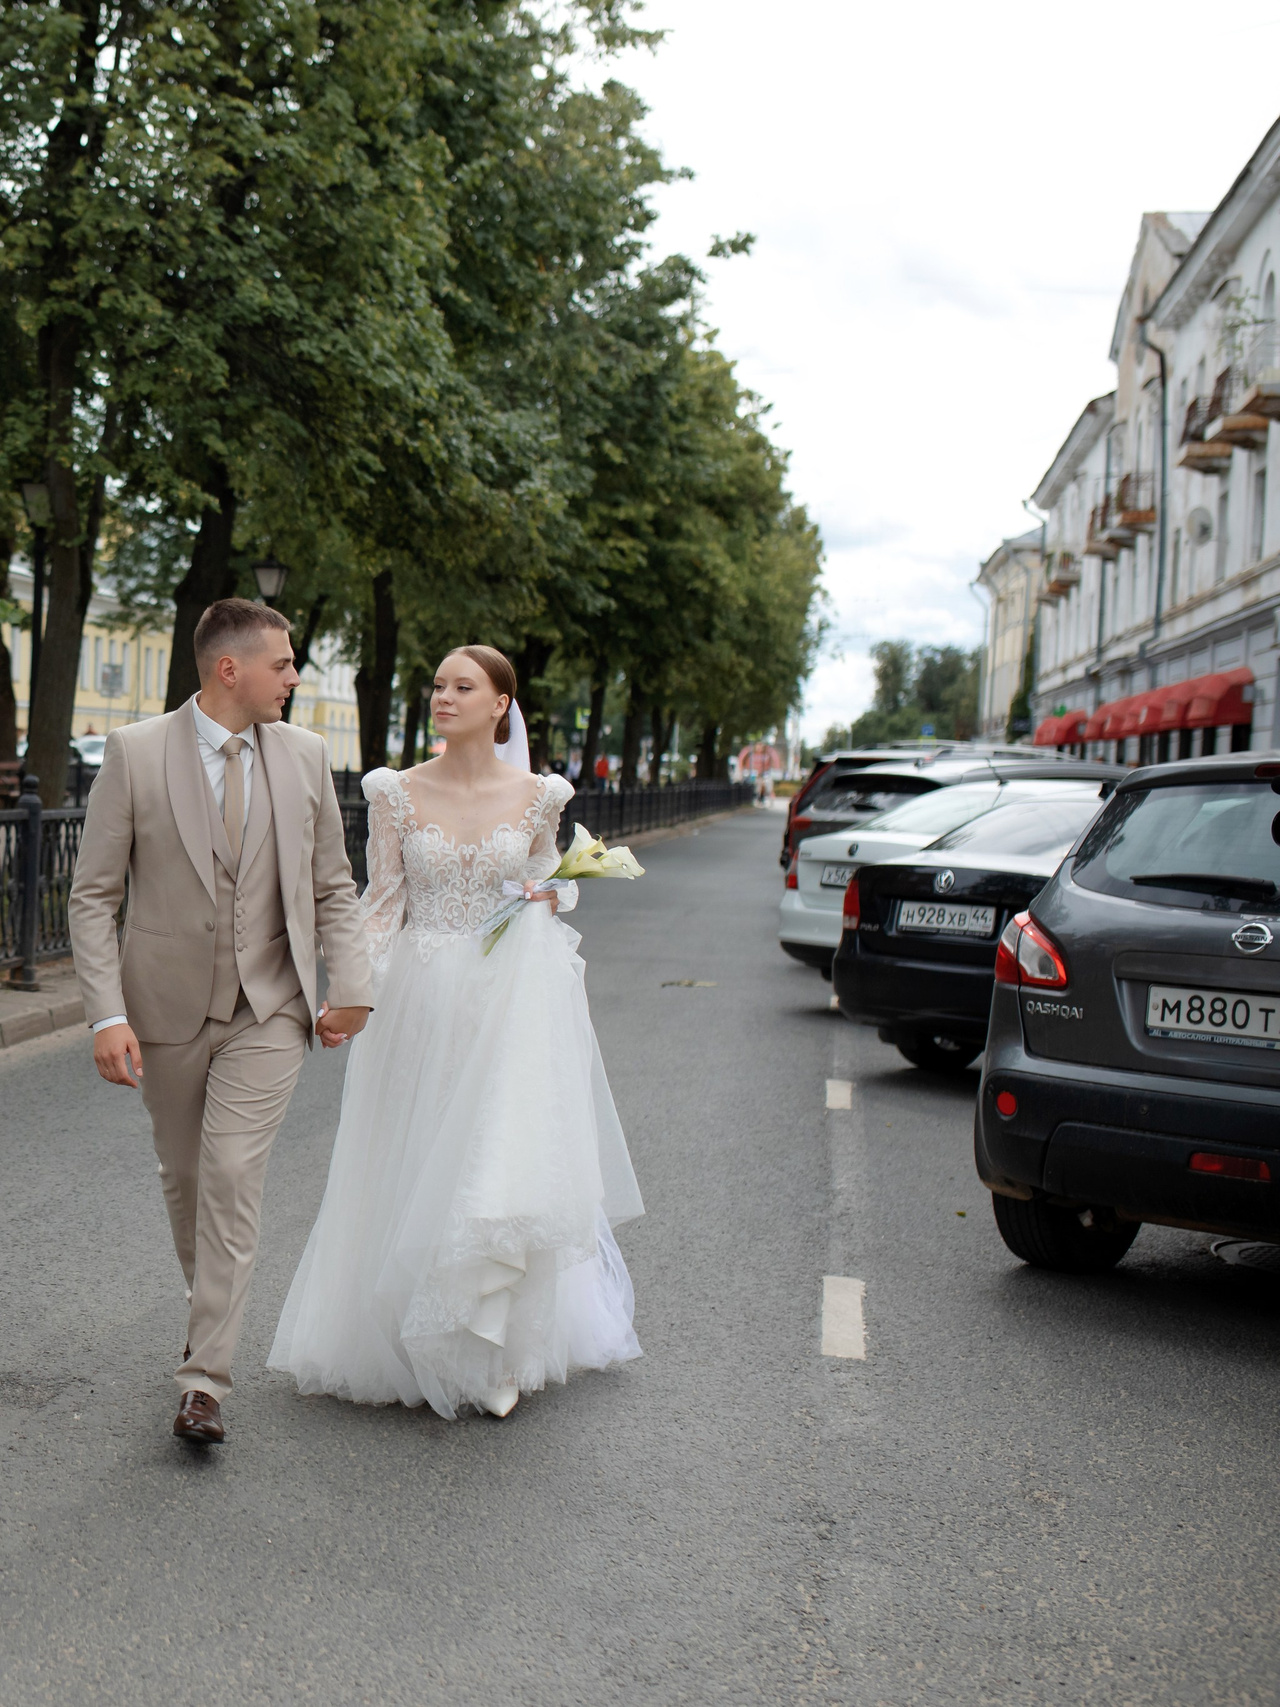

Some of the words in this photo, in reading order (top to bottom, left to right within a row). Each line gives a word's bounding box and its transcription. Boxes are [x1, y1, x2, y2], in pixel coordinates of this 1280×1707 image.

[1234, 934, 1268, 942] NISSAN
[1026, 1000, 1084, 1019] QASHQAI
[1160, 994, 1280, 1034] М880Т
[1168, 1030, 1213, 1043] АВТОСАЛОН
